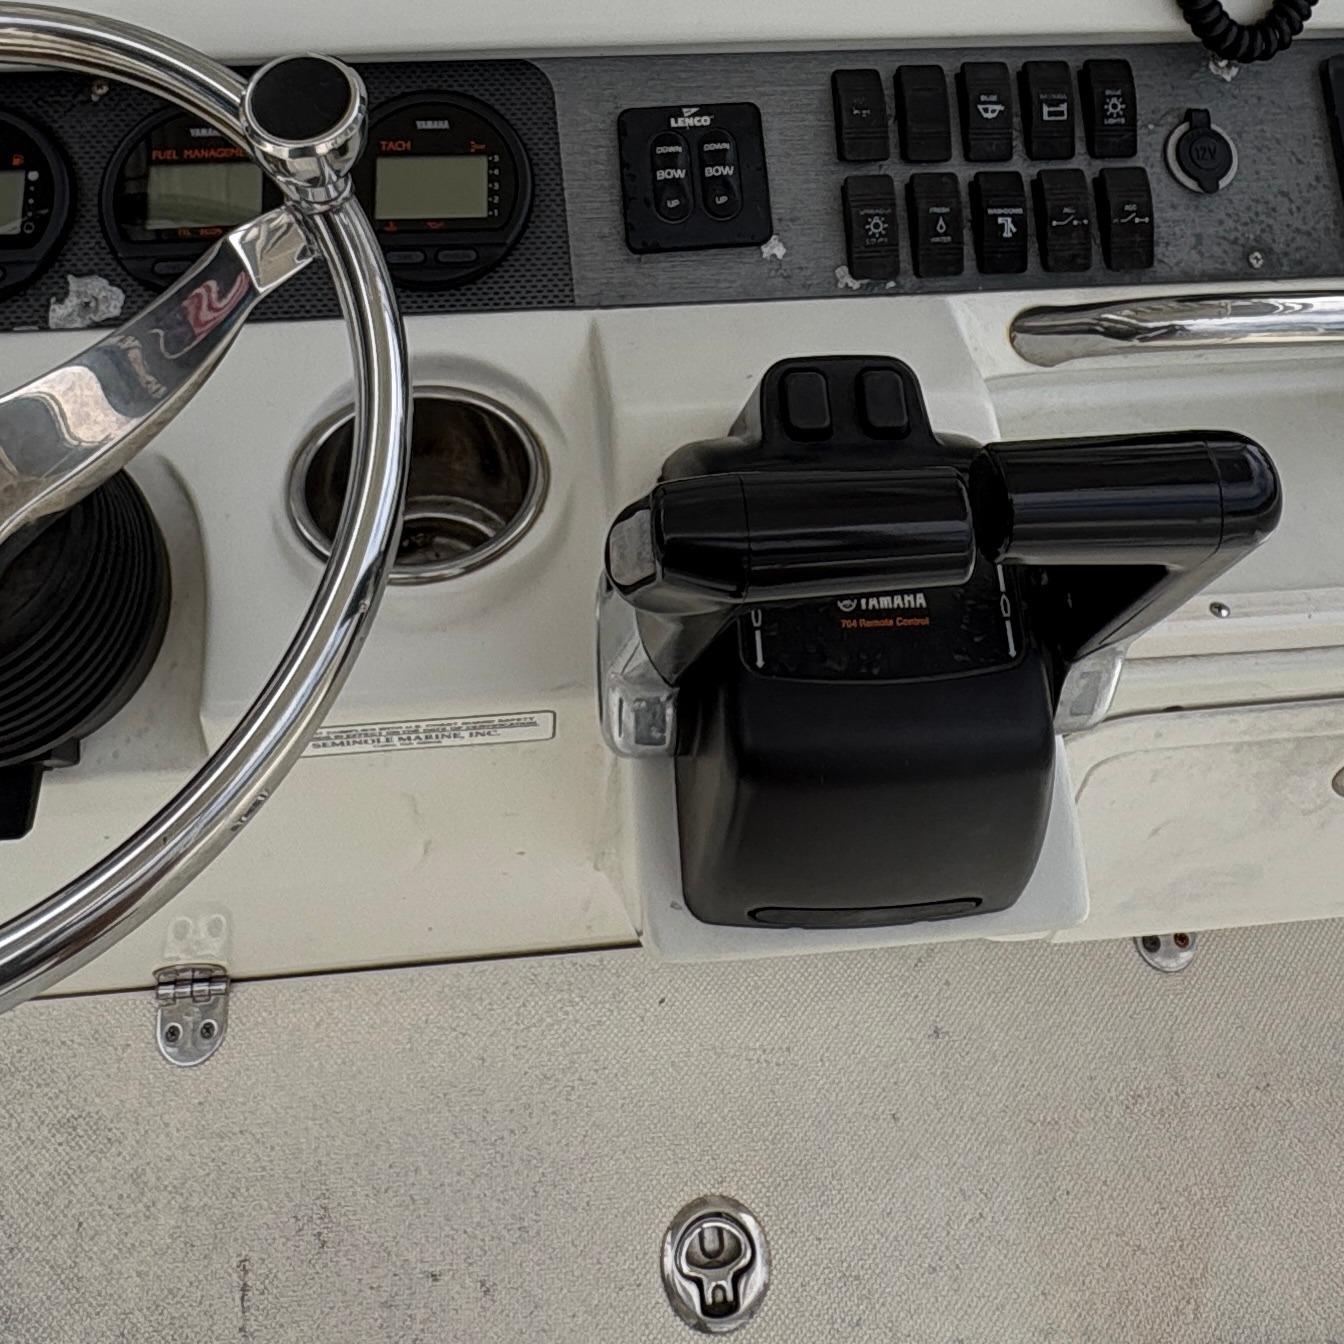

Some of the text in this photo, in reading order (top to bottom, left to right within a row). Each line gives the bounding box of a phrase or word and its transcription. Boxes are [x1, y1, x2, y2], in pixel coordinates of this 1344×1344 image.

[670, 116, 712, 128] LENCO
[381, 140, 412, 152] TACH
[152, 149, 178, 160] FUEL
[656, 165, 735, 181] BOW BOW
[666, 195, 729, 209] UP UP
[860, 594, 927, 610] YAMAHA
[840, 615, 930, 628] 704 Remote Control
[312, 736, 394, 750] SEMINOLE
[397, 731, 465, 743] MARINE,
[468, 729, 501, 739] INC.
